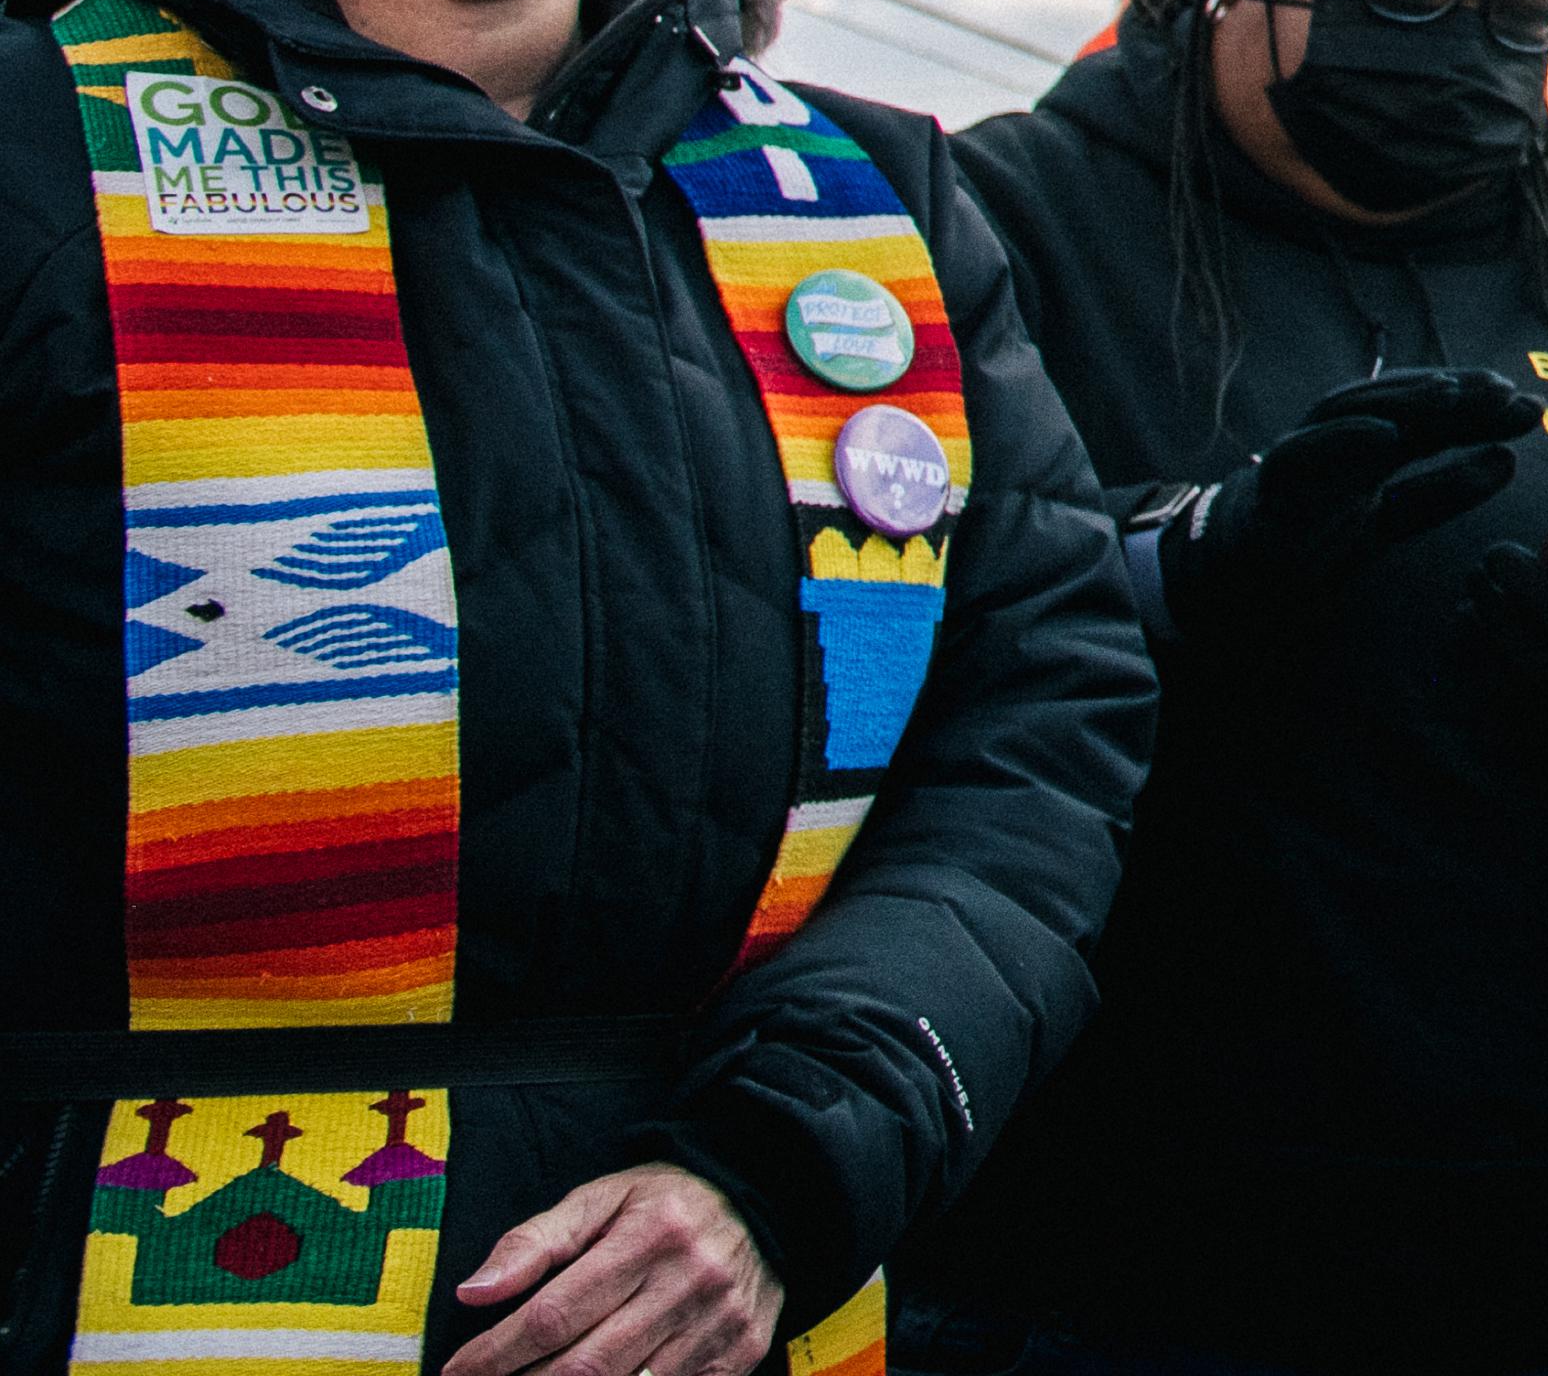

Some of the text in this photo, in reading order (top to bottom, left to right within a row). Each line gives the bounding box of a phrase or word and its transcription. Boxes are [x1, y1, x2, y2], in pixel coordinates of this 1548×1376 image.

[146, 126, 353, 167] MADE
[153, 164, 356, 193] ME THIS
[158, 192, 361, 215] FABULOUS
[845, 446, 947, 487] WWWD
[918, 1016, 974, 1132] OMNI-HEAT
